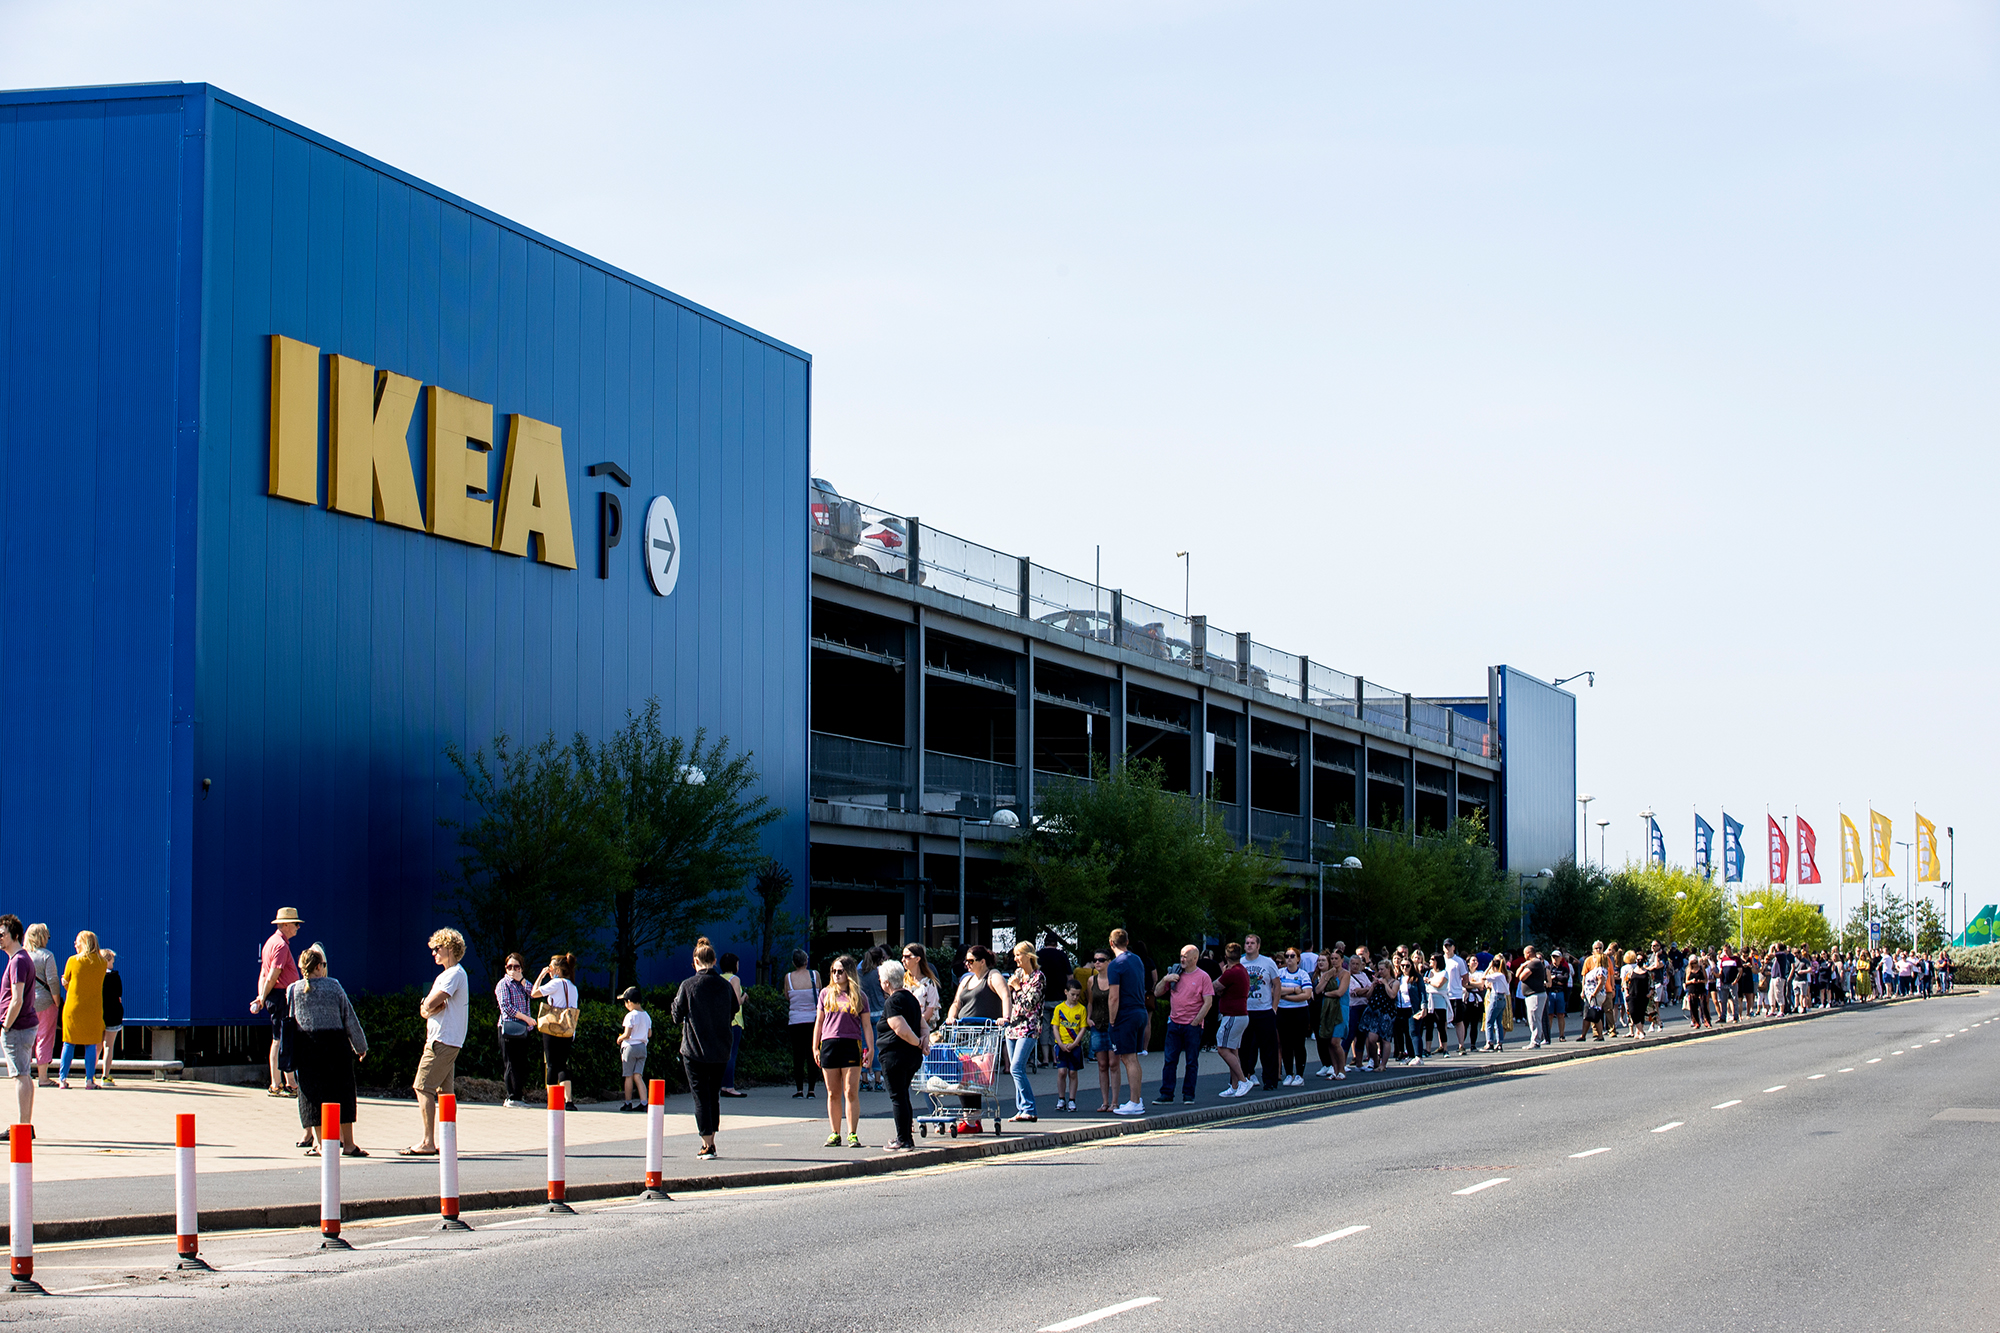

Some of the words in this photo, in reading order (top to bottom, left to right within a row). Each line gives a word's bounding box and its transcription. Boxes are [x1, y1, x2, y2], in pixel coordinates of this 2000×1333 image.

[268, 334, 577, 570] IKEA
[599, 491, 623, 580] P
[1726, 826, 1736, 877] IKEA
[1772, 828, 1781, 879] IKEA
[1800, 830, 1810, 880] IKEA
[1845, 826, 1854, 879] IKEA
[1874, 823, 1884, 874] IKEA
[1920, 826, 1929, 878] IKEA
